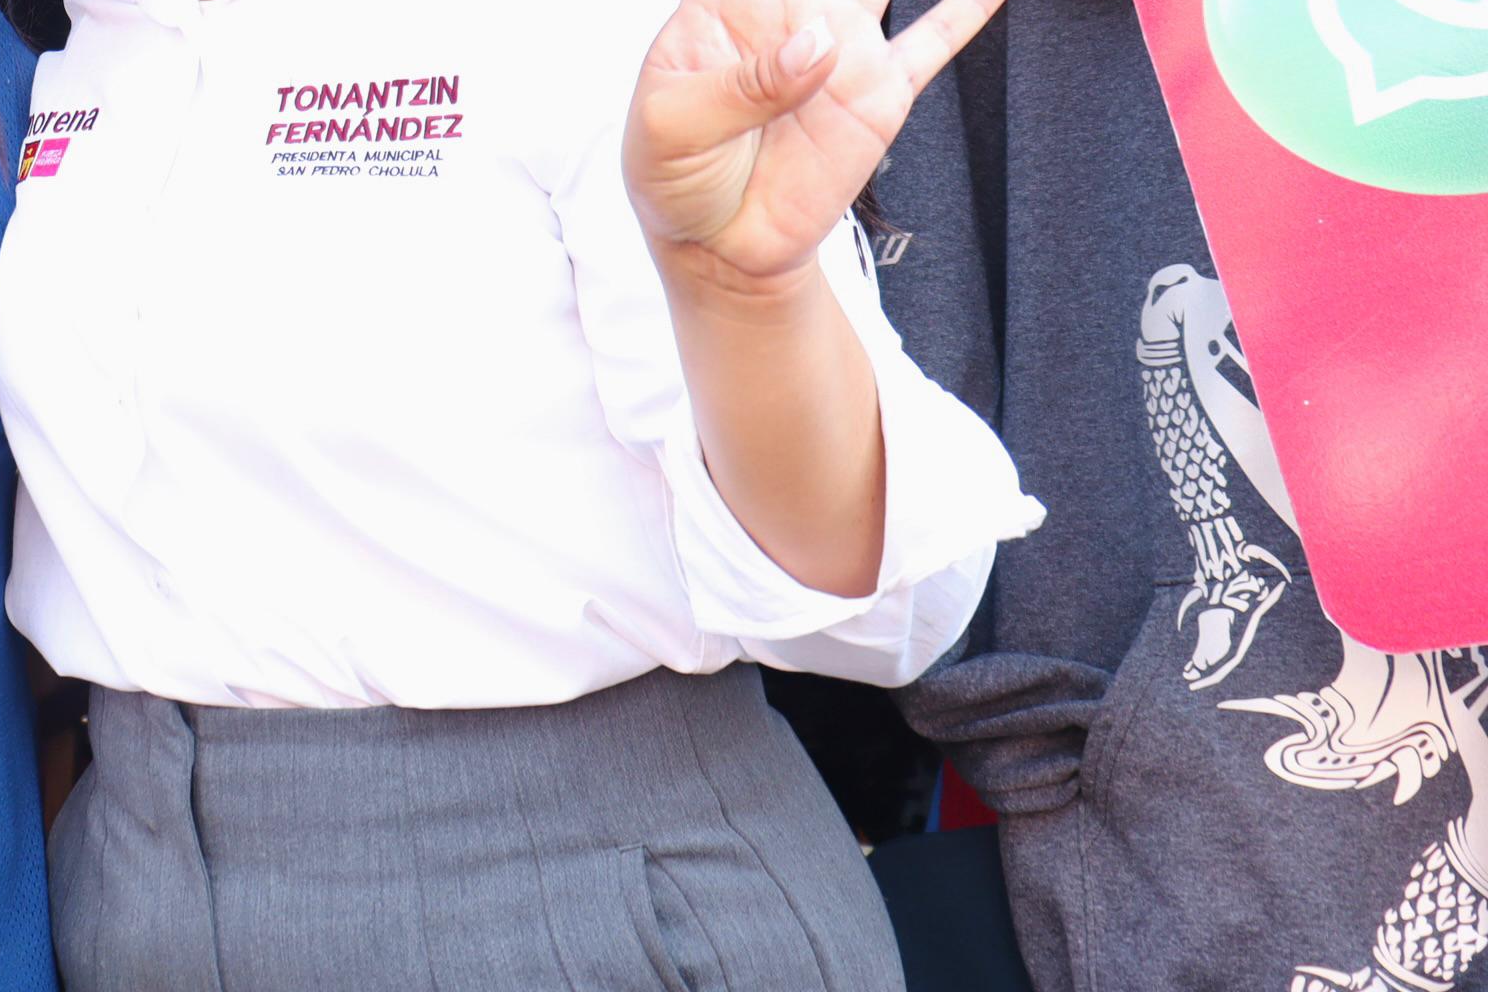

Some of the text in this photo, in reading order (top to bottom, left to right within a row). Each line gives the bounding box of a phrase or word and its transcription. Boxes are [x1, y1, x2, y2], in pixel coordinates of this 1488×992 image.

[277, 75, 459, 112] TONANTZIN
[266, 109, 464, 145] FERNÁNDEZ
[271, 149, 444, 164] PRESIDENTA MUNICIPAL
[276, 165, 439, 177] SAN PEDRO CHOLULA
